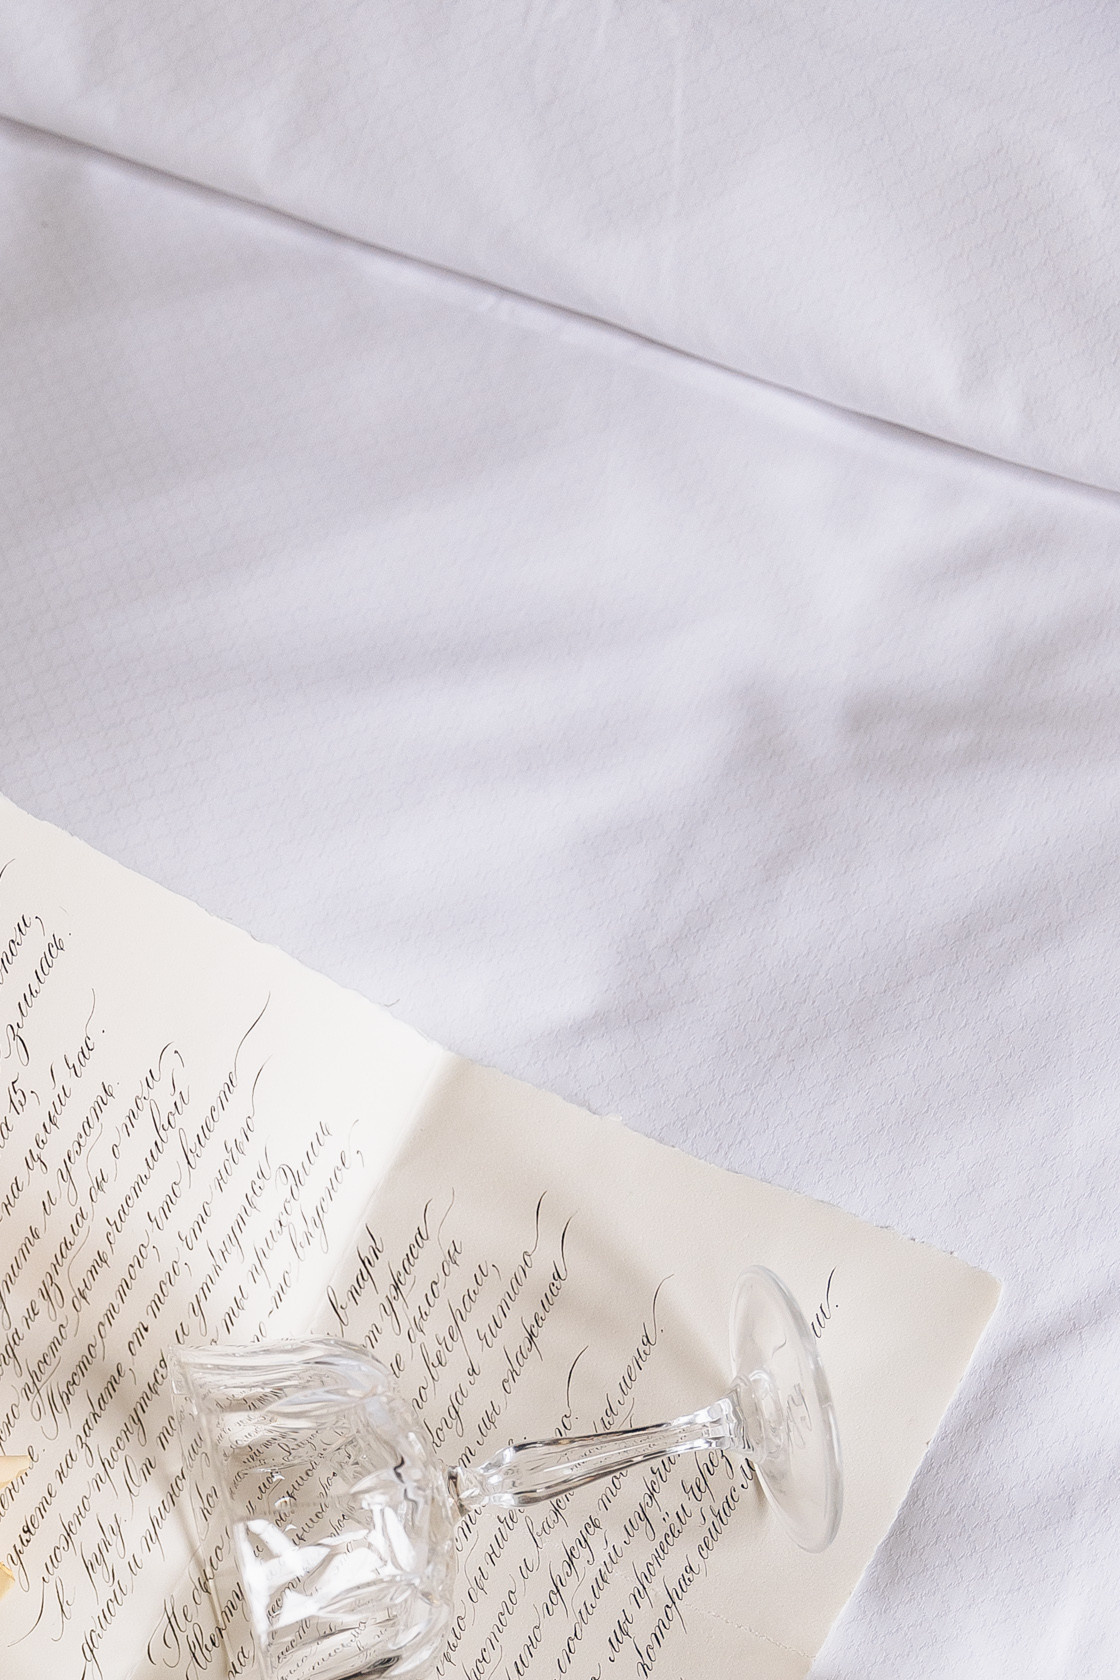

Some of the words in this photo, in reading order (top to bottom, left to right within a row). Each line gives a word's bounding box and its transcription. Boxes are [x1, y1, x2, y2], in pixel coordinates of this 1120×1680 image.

[5, 931, 72, 1066] злилась.
[1, 1175, 26, 1216] на
[20, 1060, 73, 1186] целый
[62, 987, 105, 1079] час.
[7, 1072, 40, 1116] 15,
[54, 1080, 120, 1206] уехать.
[17, 1314, 70, 1402] просто
[66, 1224, 111, 1337] быть
[112, 1067, 192, 1254] счастливой
[22, 1299, 42, 1330] не
[37, 1207, 90, 1321] узнала
[120, 1040, 185, 1137] том,
[289, 1118, 364, 1282] вкусное,
[379, 1197, 433, 1335] ужаса
[4, 1483, 58, 1592] уляете
[53, 1449, 78, 1485] на
[72, 1361, 136, 1467] закате,
[128, 1320, 151, 1366] от
[145, 1246, 192, 1320] того,
[177, 1189, 215, 1249] что
[212, 1052, 274, 1193] ночью
[30, 1335, 101, 1440] Просто
[97, 1301, 120, 1362] от
[114, 1228, 160, 1304] того,
[147, 1157, 185, 1230] что
[91, 1347, 170, 1498] проснуться
[186, 1134, 273, 1336] уткнуться
[401, 1271, 442, 1359] было
[420, 1263, 502, 1395] вечерам,
[474, 1399, 501, 1446] мы
[503, 1210, 578, 1409] окажемся
[476, 1189, 547, 1352] читаю
[53, 1575, 76, 1641] в
[80, 1513, 126, 1606] руку.
[220, 1283, 250, 1334] ты
[247, 1118, 333, 1288] приходишь
[614, 1300, 665, 1406] меня.
[147, 1594, 197, 1666] Не
[347, 1222, 385, 1306] парк
[542, 1517, 603, 1618] горжусь
[605, 1608, 634, 1662] мы
[629, 1505, 692, 1609] пронесём
[634, 1554, 698, 1679] которая
[697, 1486, 743, 1576] сейчас
